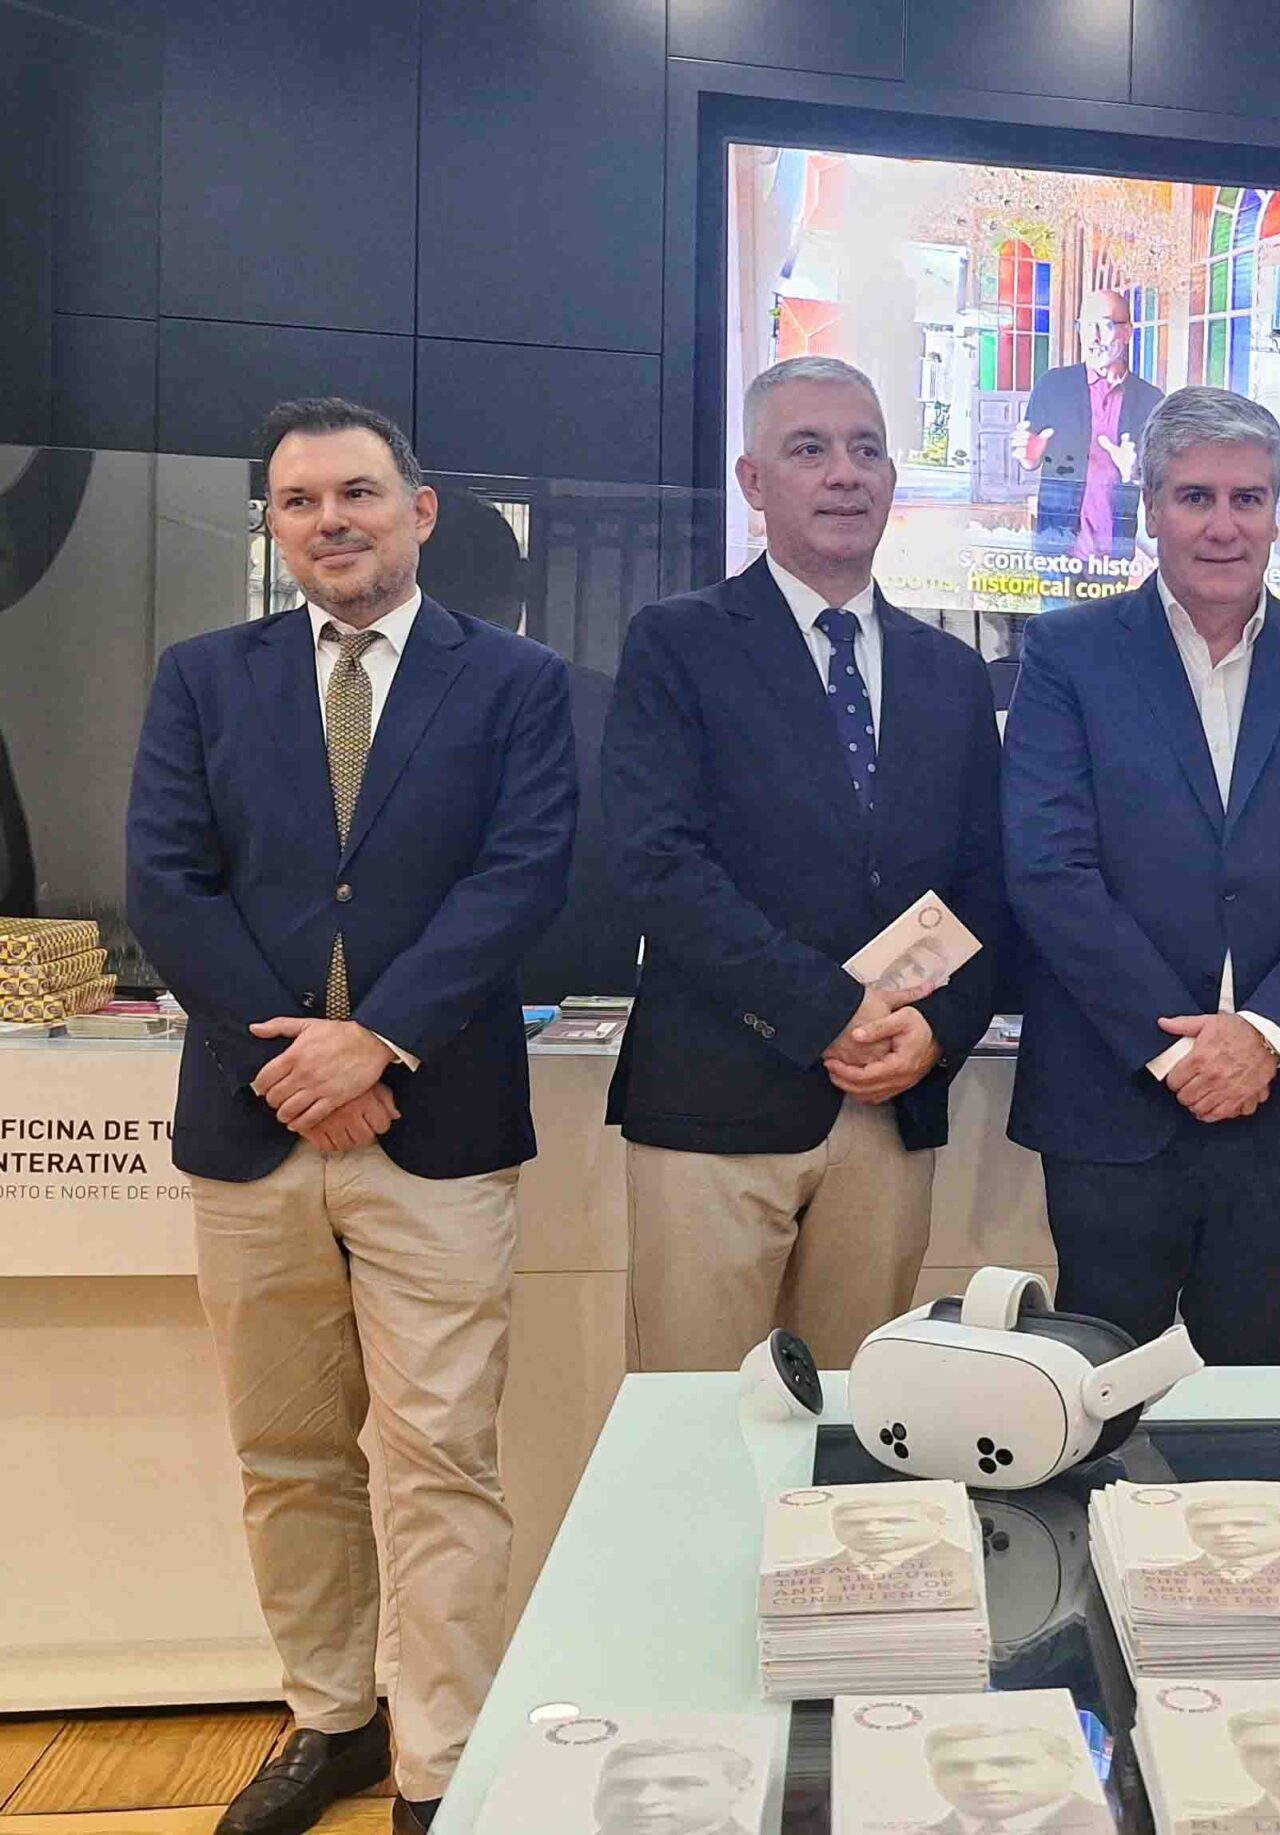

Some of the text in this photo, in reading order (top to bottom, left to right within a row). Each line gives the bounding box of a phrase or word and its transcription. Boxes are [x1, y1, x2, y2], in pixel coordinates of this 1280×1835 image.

[984, 552, 1082, 575] contexto
[969, 570, 1069, 597] historical
[1075, 581, 1133, 598] cont
[1, 1119, 94, 1140] FICINA
[105, 1120, 139, 1141] DE
[45, 1185, 57, 1199] E
[62, 1185, 120, 1200] NORTE
[127, 1186, 149, 1200] DE
[775, 1562, 880, 1577] LEGACY
[773, 1577, 822, 1586] THE
[774, 1586, 825, 1596] AND
